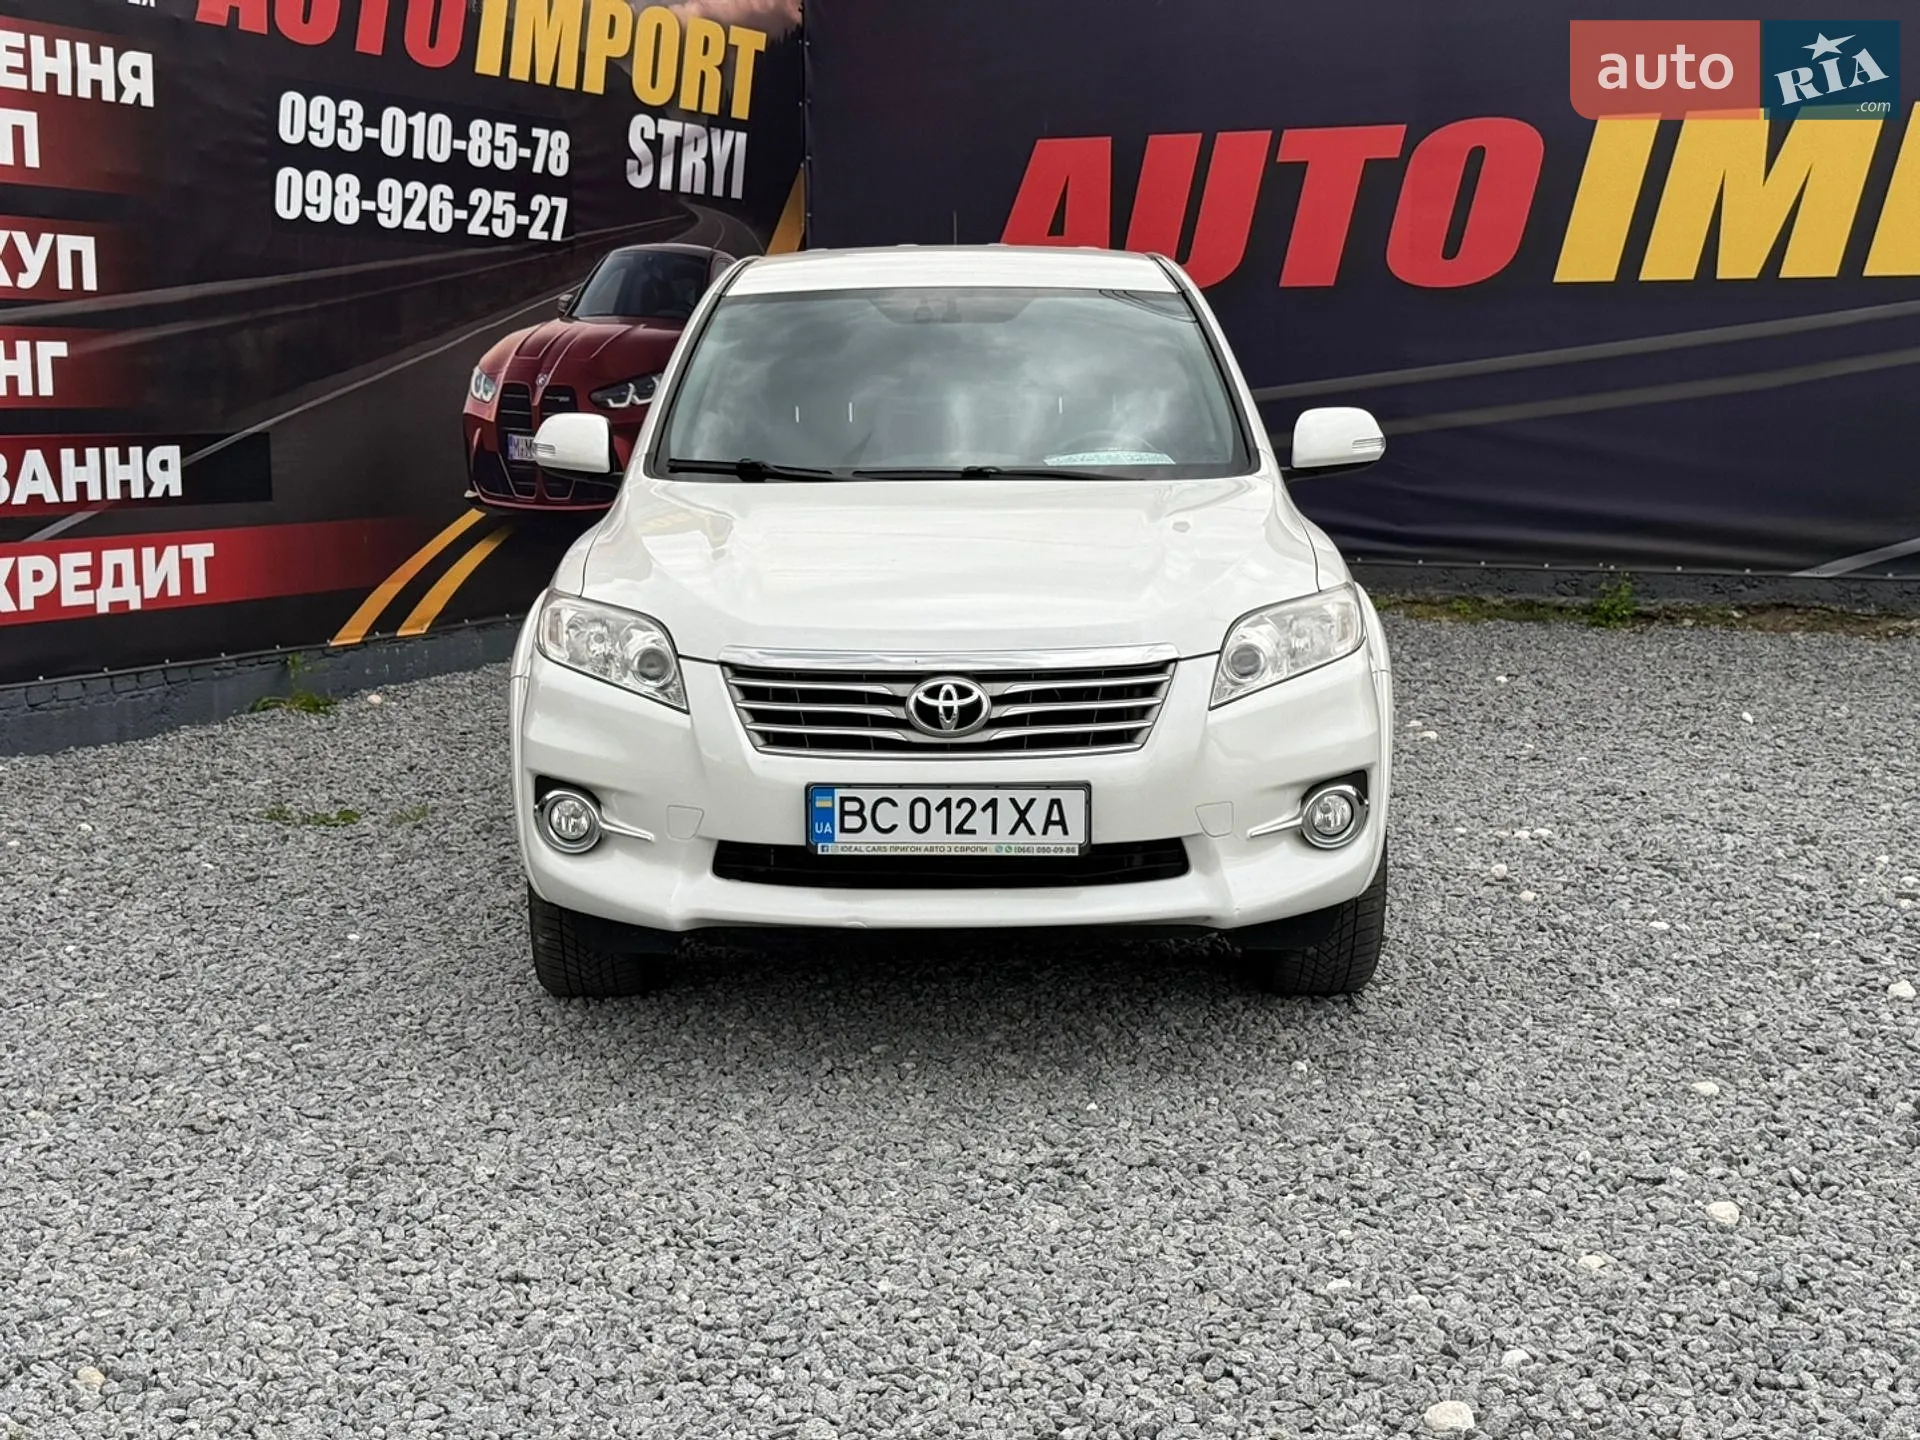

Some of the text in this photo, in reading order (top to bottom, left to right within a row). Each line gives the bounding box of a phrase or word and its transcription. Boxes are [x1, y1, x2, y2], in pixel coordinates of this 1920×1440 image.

[278, 91, 570, 177] 093-010-85-78
[625, 114, 748, 199] STRYI
[275, 167, 568, 241] 098-926-25-27
[0, 445, 182, 505] АННЯ
[815, 823, 833, 834] UA
